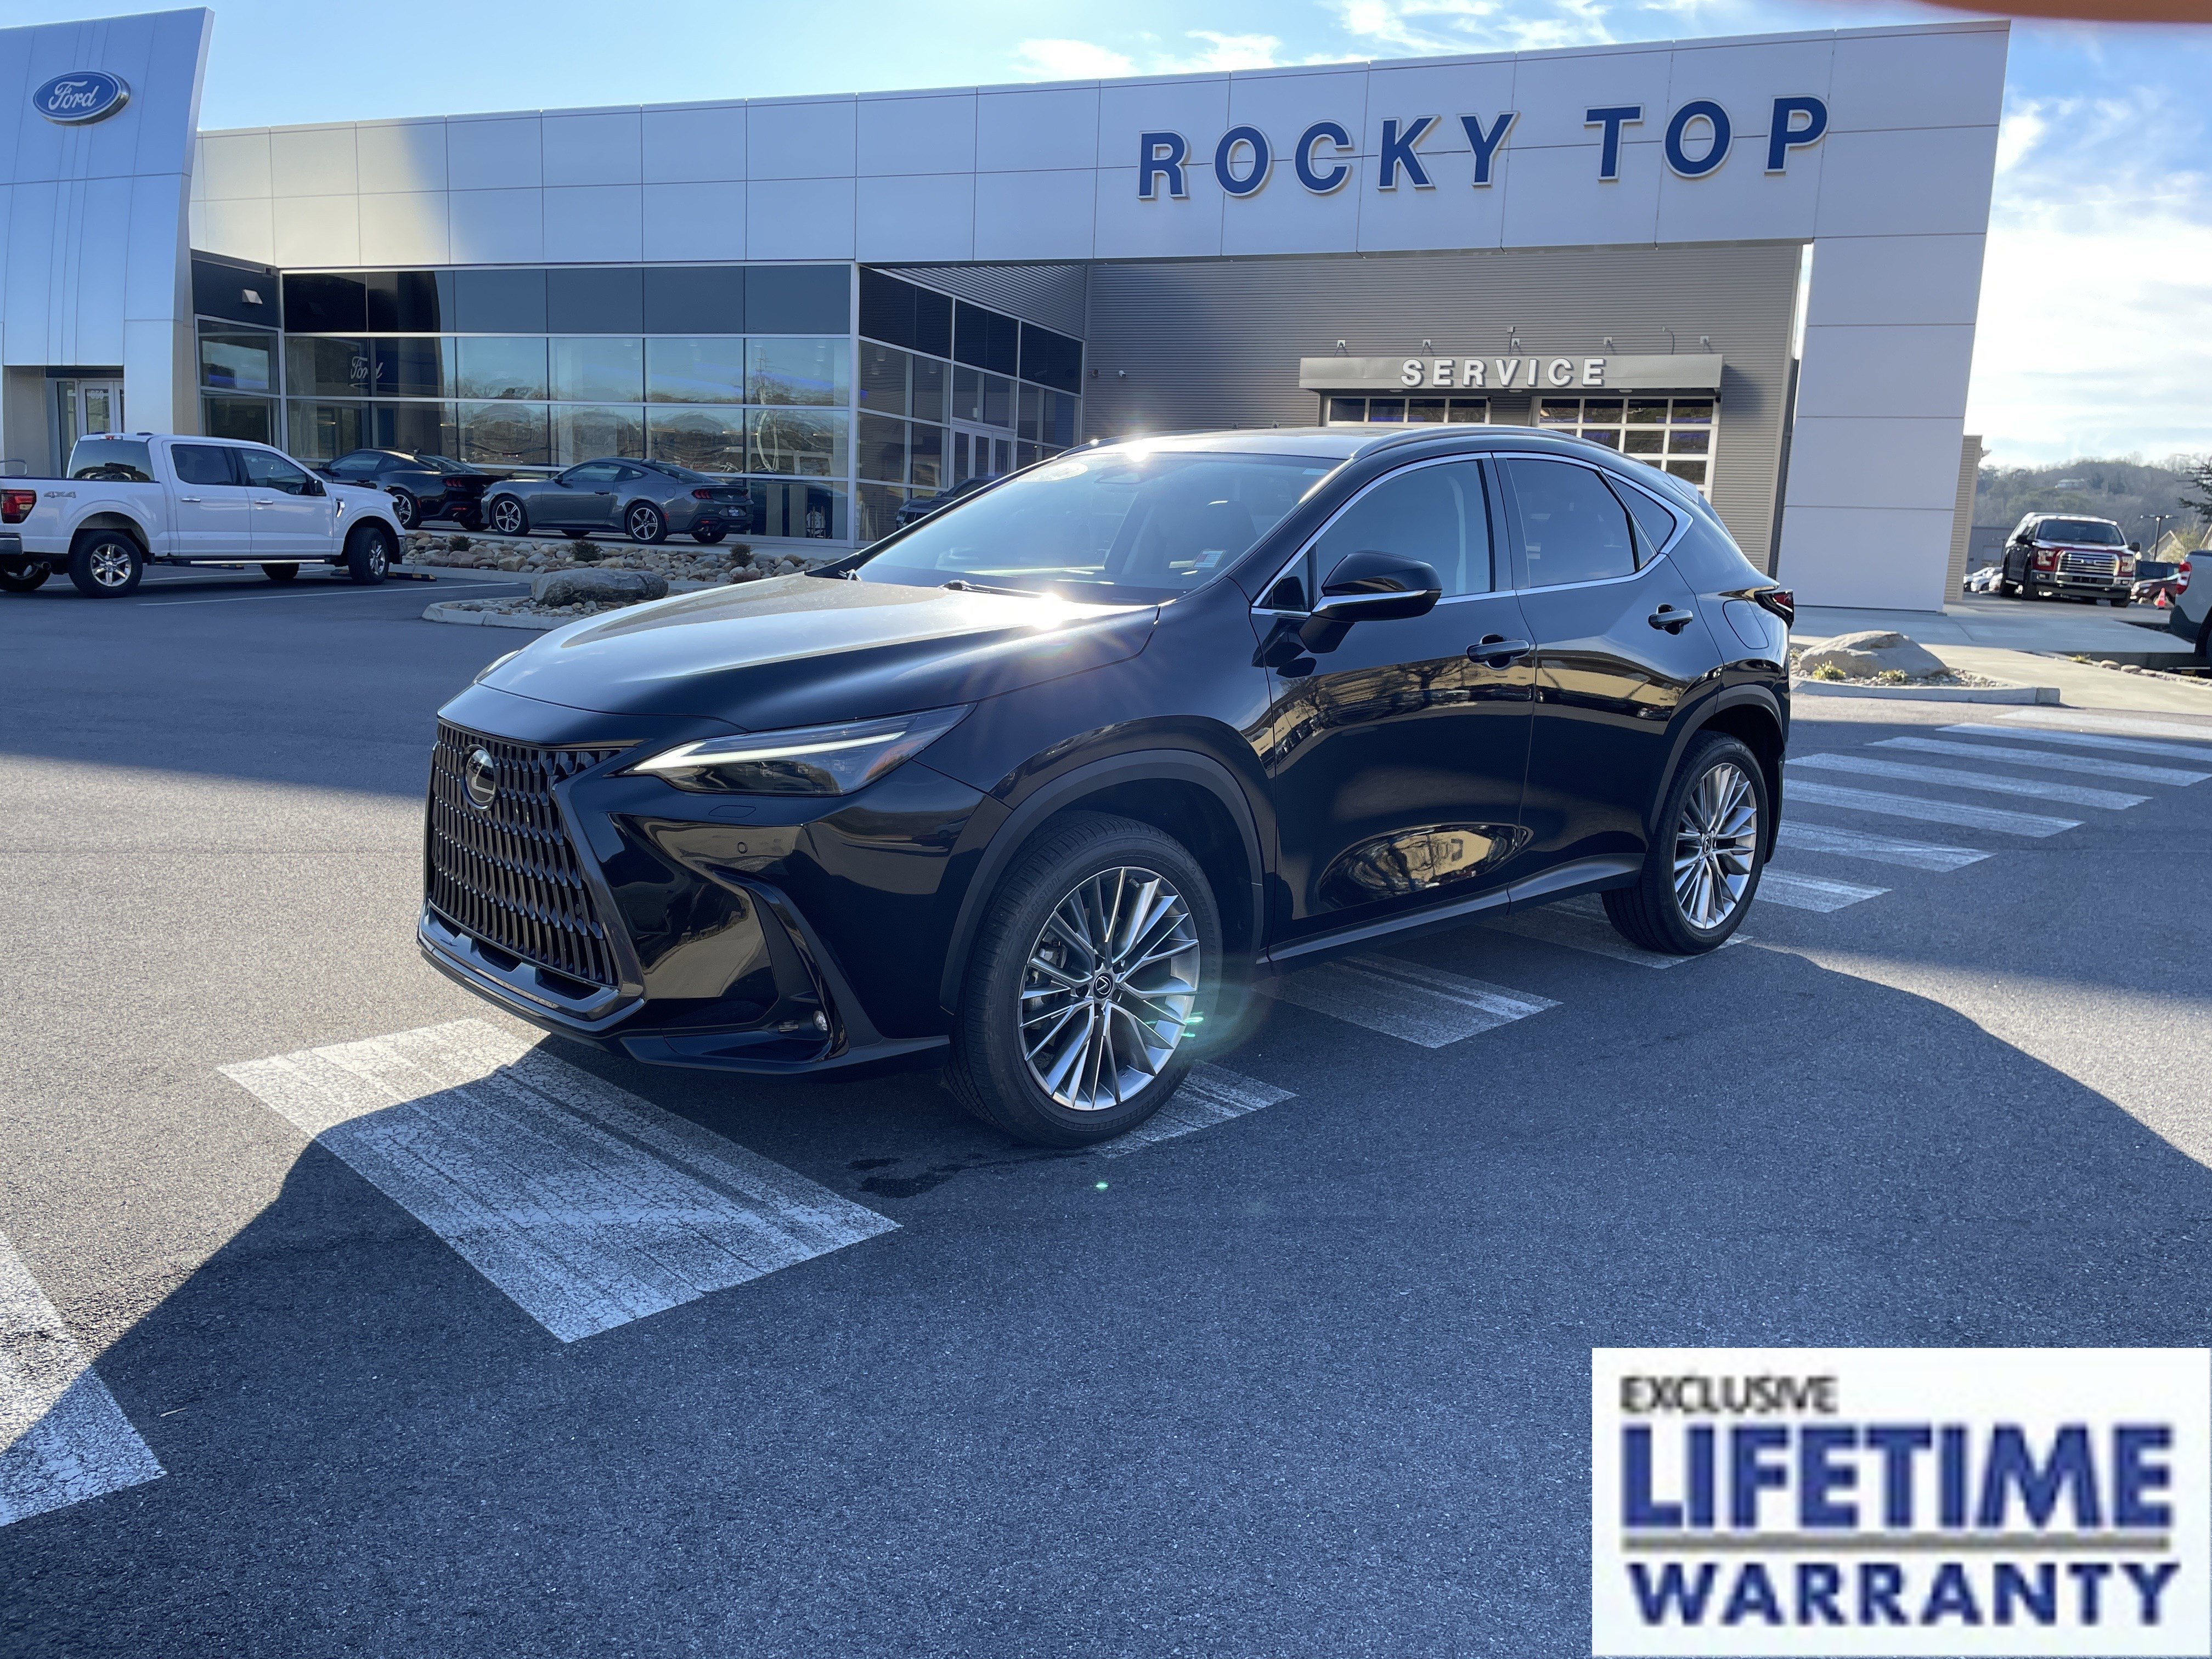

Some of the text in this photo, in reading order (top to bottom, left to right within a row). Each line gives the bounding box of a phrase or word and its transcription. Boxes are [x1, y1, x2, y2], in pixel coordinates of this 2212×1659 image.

[48, 80, 100, 110] Ford
[1137, 94, 1830, 200] ROCKY TOP
[1401, 358, 1605, 387] SERVICE
